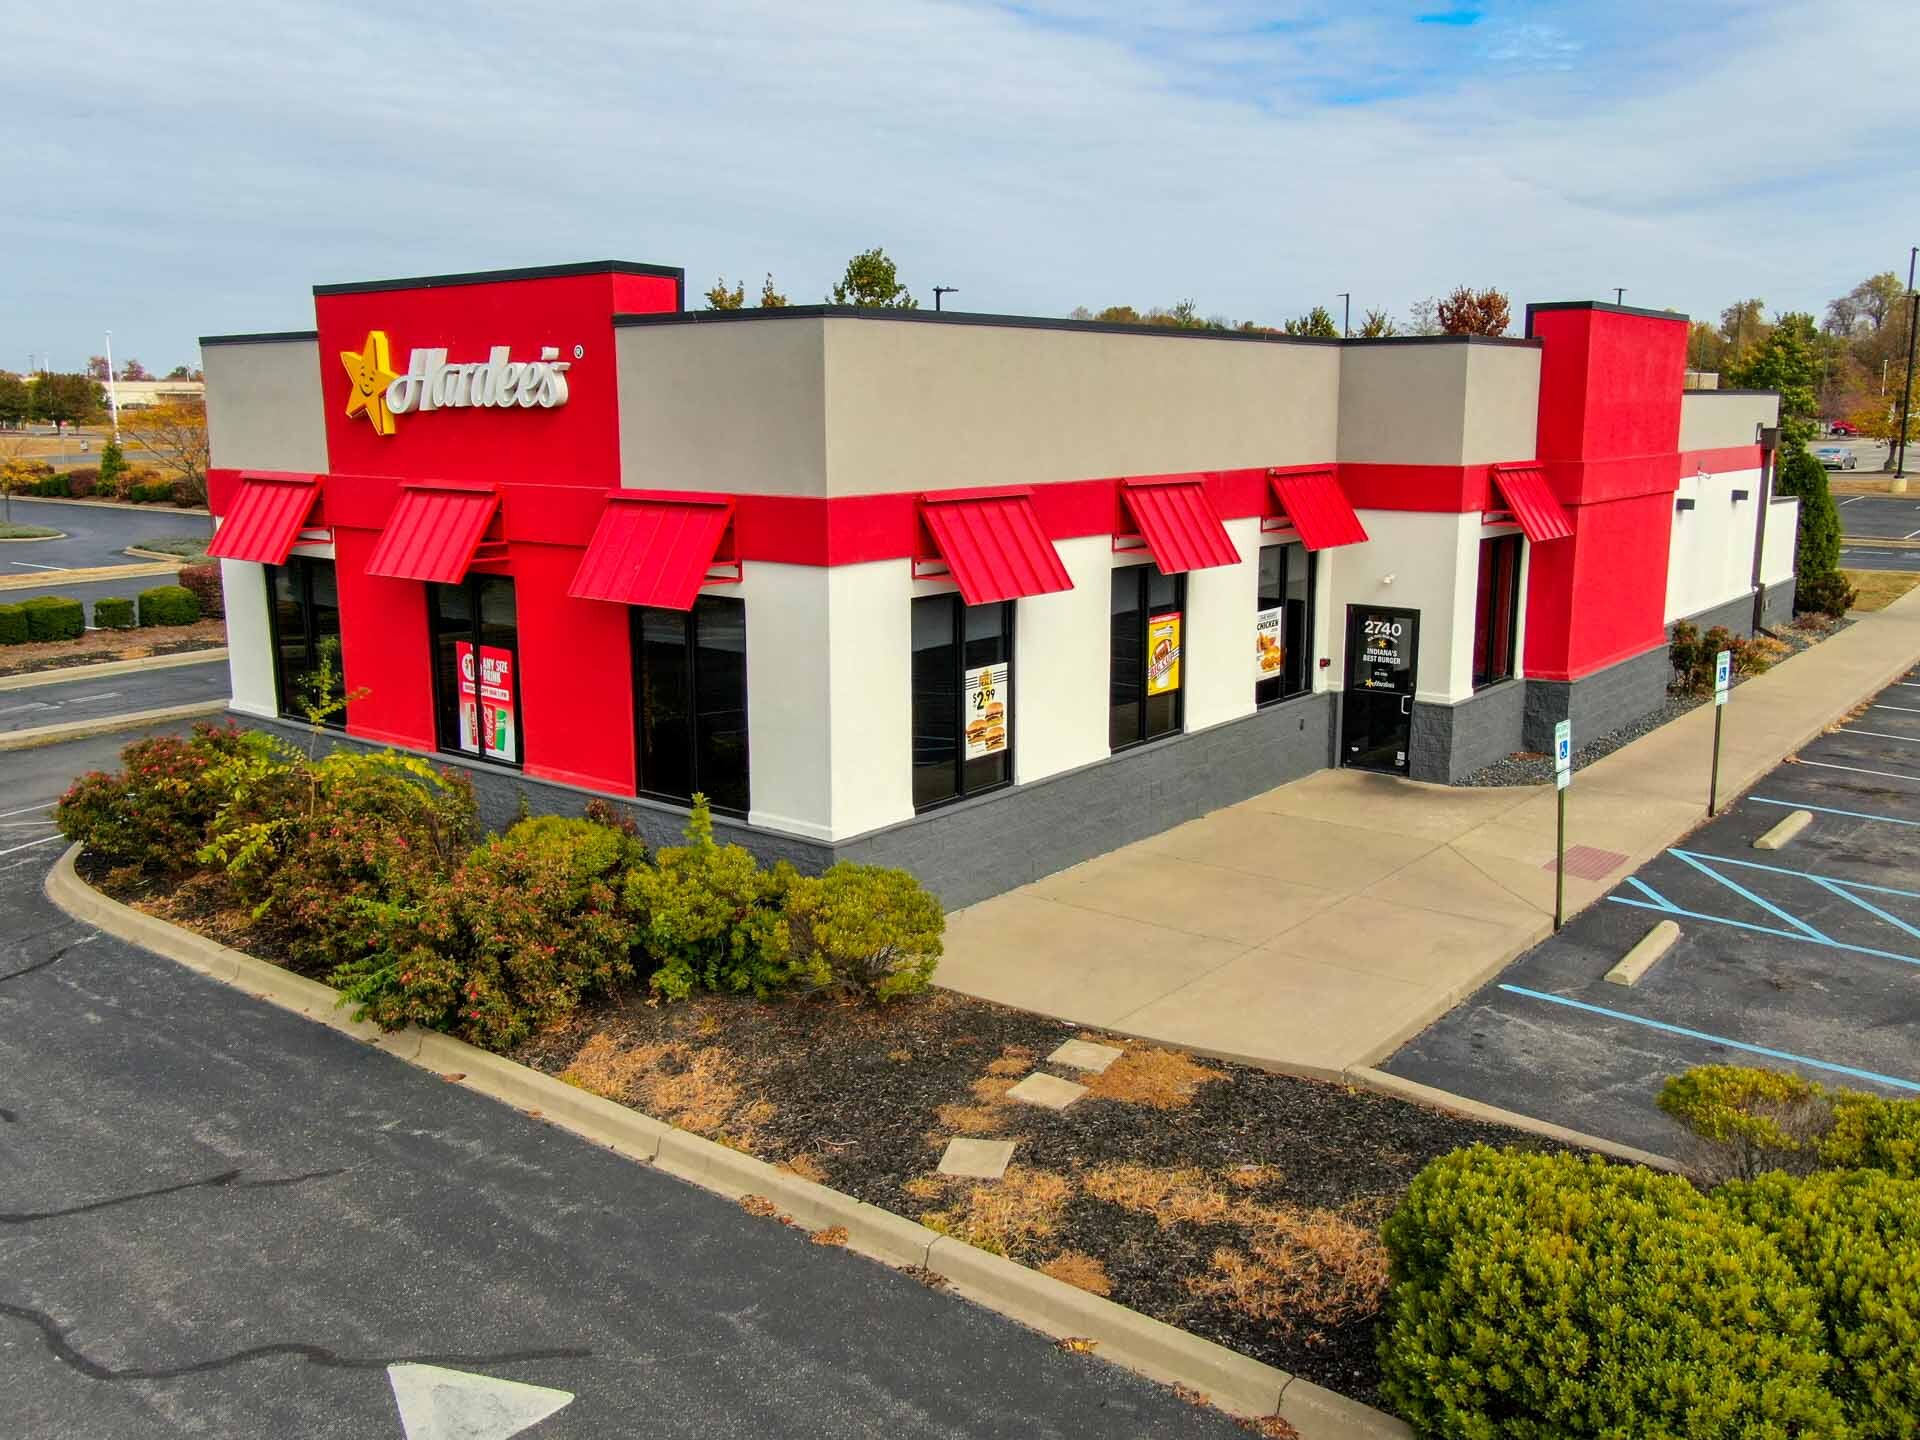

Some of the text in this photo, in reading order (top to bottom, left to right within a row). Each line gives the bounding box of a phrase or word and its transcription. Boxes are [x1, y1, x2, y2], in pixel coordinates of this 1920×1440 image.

[386, 346, 571, 414] Hardee's
[1257, 619, 1279, 631] CHICKEN
[1364, 620, 1402, 636] 2740
[1366, 647, 1398, 657] INDIANA'S
[495, 659, 509, 673] SIZE
[1362, 654, 1401, 665] BEST BURGER
[972, 688, 996, 711] $2.99
